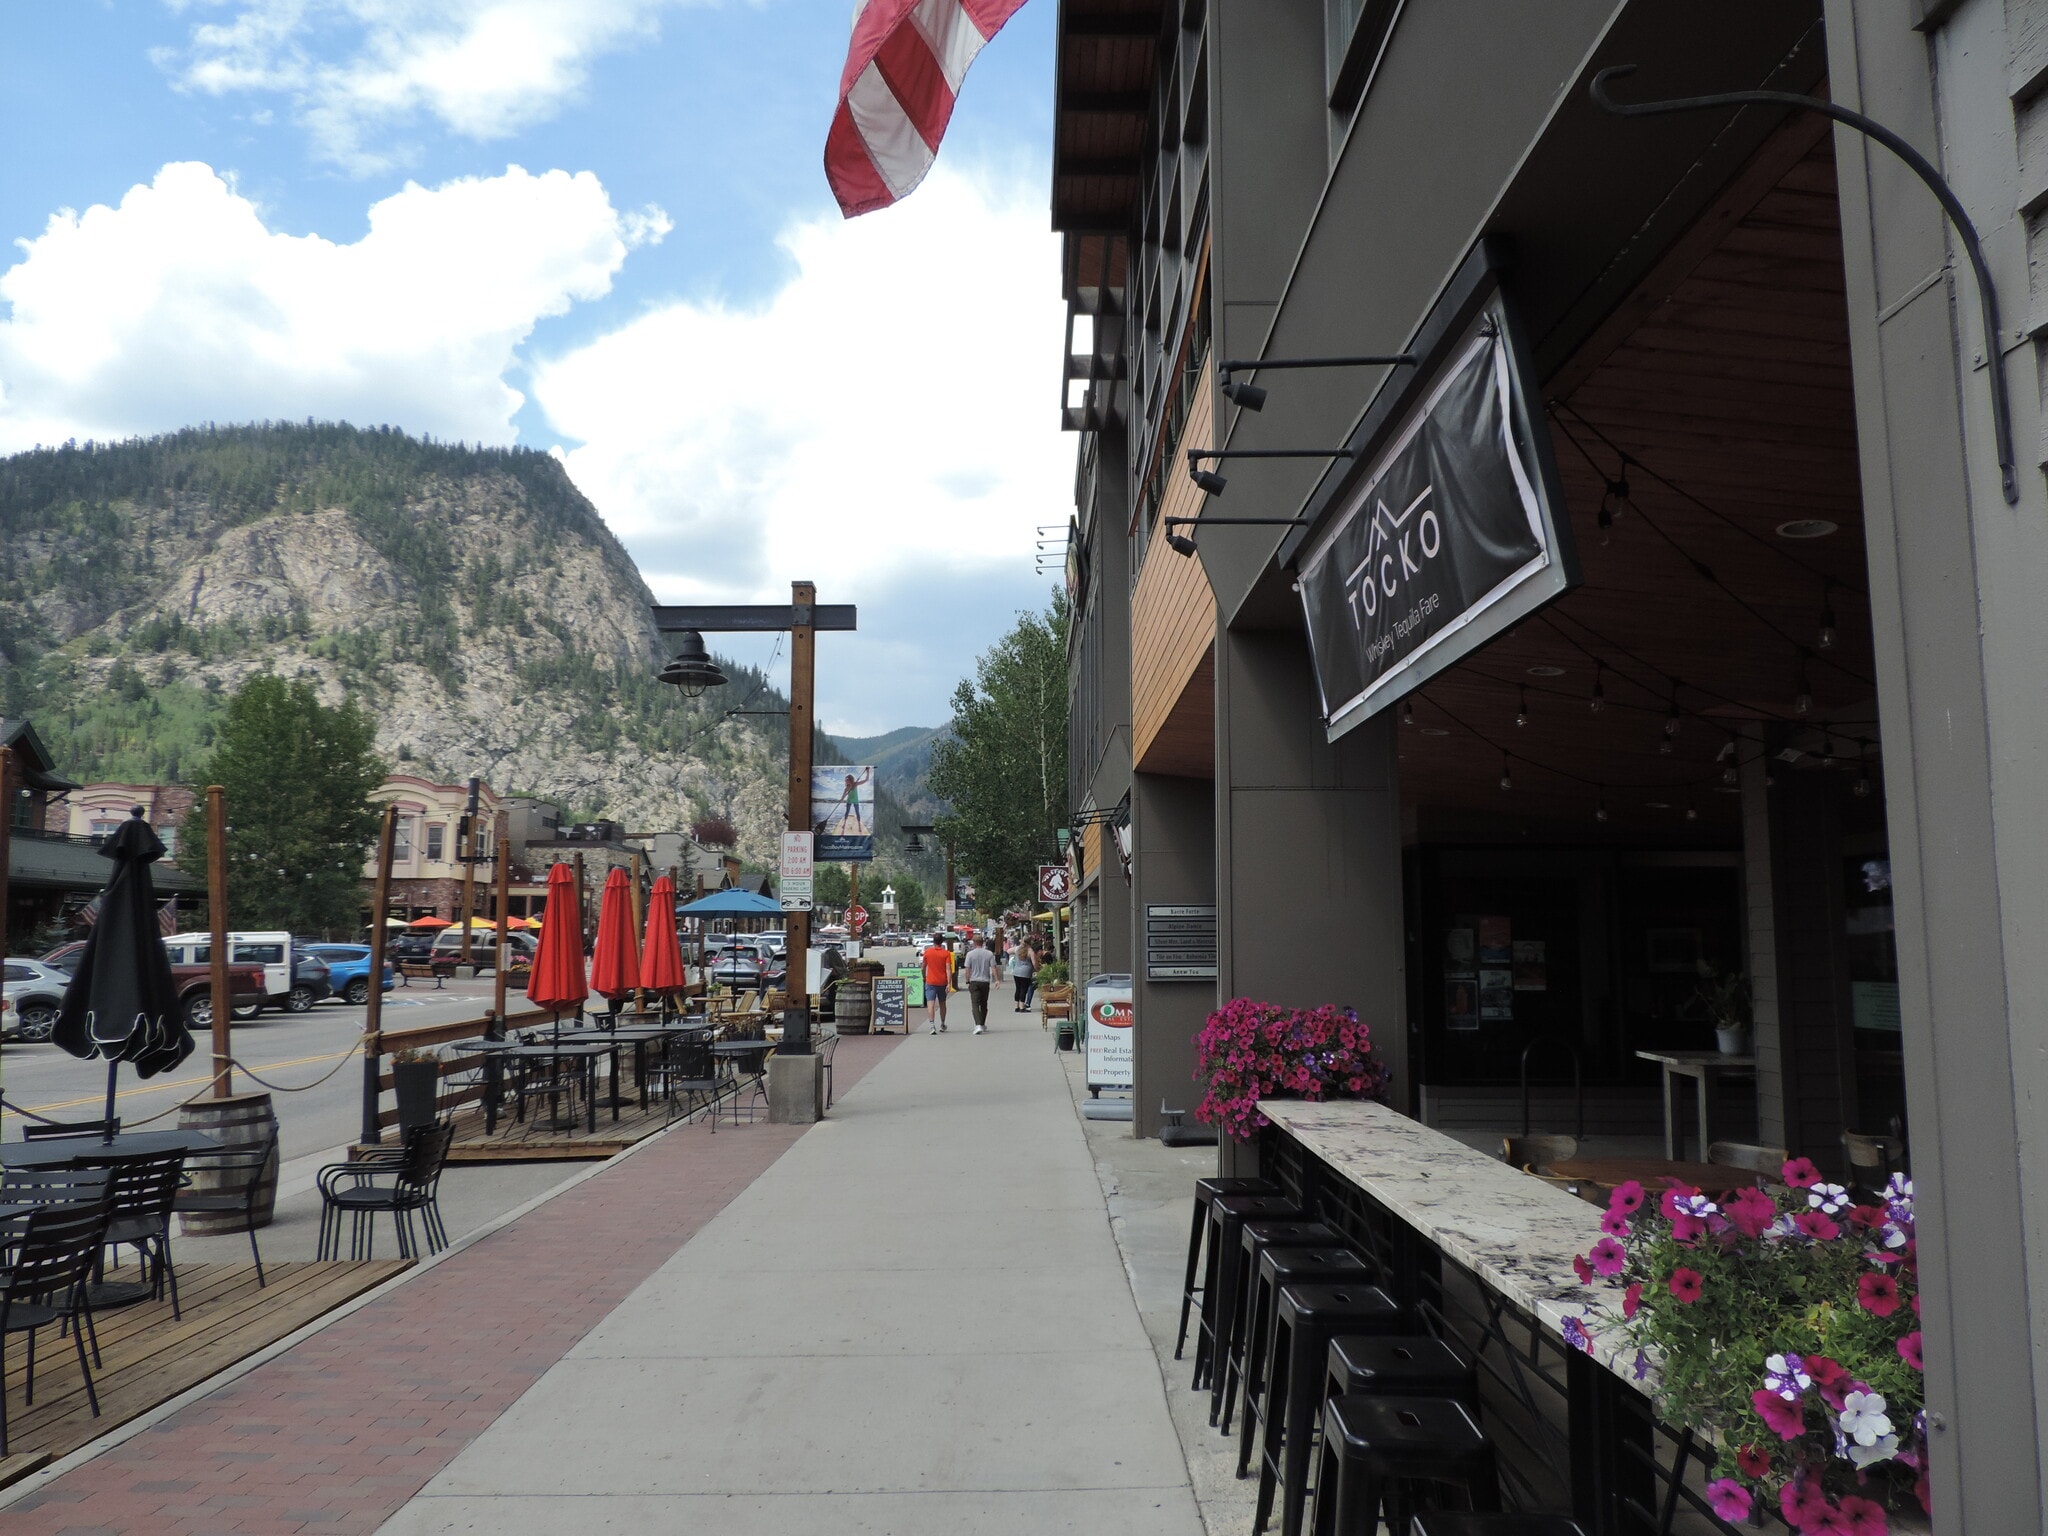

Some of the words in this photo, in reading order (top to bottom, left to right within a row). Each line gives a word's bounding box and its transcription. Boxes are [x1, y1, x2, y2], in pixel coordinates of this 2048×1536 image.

[1349, 510, 1440, 630] TOCKO
[1366, 630, 1394, 663] Whiskey
[1392, 607, 1420, 639] Tequila
[1419, 593, 1439, 618] Fare
[794, 834, 801, 842] NO
[846, 912, 865, 920] SOP
[1103, 1069, 1130, 1077] Property
